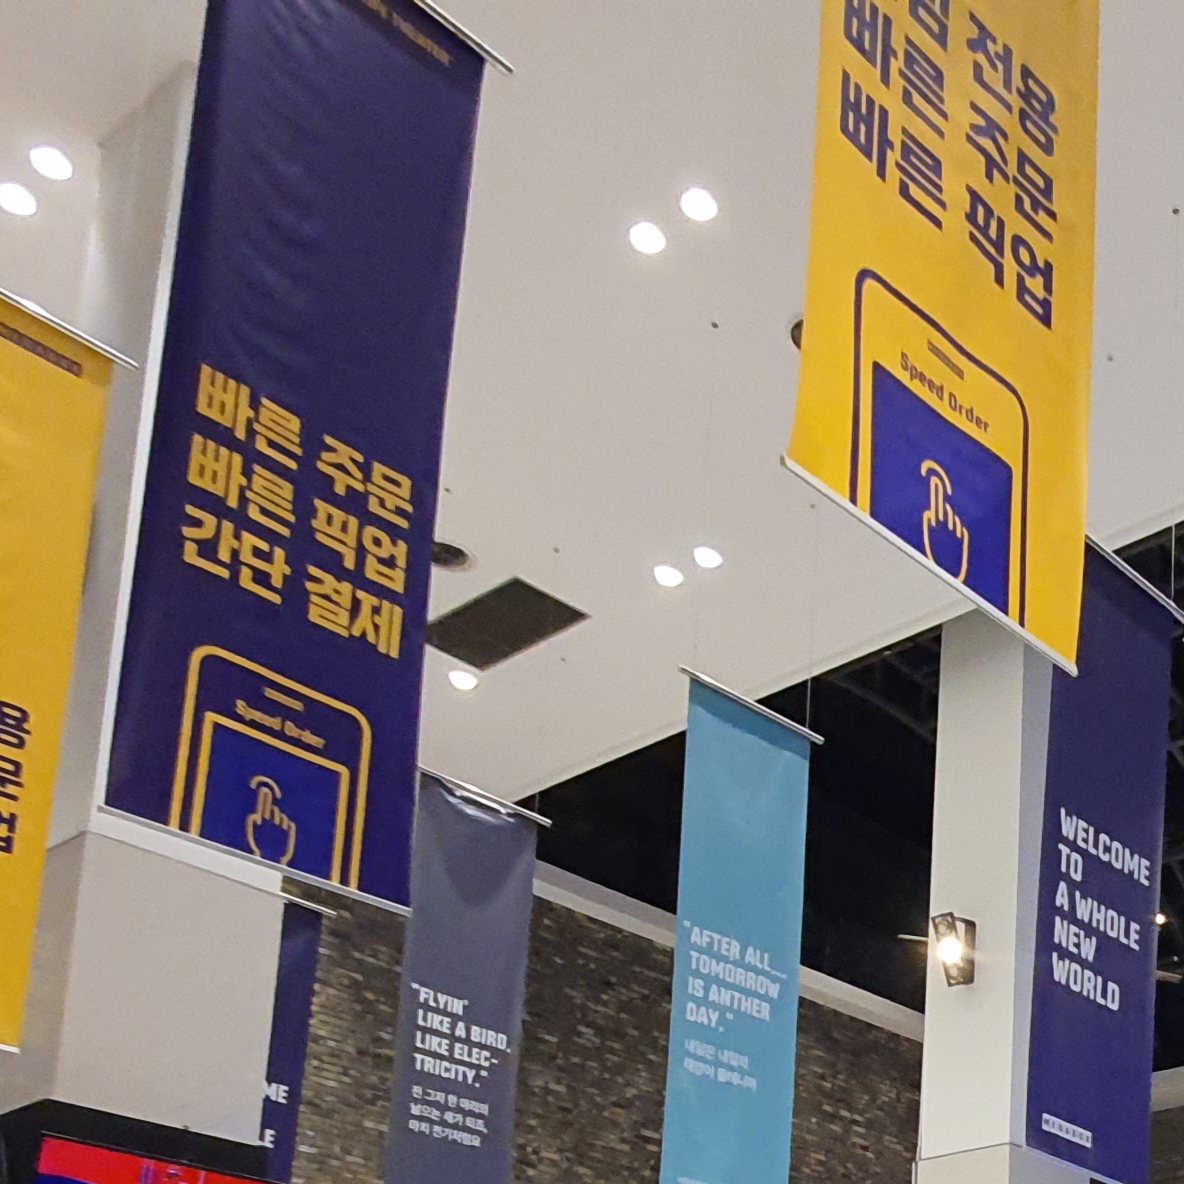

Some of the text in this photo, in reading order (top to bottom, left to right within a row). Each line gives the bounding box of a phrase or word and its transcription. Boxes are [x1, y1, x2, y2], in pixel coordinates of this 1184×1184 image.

[965, 10, 1059, 157] 전용
[844, 0, 1057, 244] 빠른 주문
[840, 66, 1054, 330] 빠른 픽업
[900, 351, 989, 433] Speed Order
[196, 362, 413, 530] 빠른 주문
[186, 432, 408, 594] 빠른 픽업
[181, 503, 404, 660] 간단 결제
[1058, 843, 1082, 882] TO
[1060, 807, 1151, 887] WELCOME
[1054, 916, 1097, 963] NEW
[1055, 880, 1141, 951] A WHOLE
[687, 975, 705, 998] IS
[689, 950, 781, 999] TOMORROW
[1052, 951, 1121, 1012] WORLD
[415, 1030, 499, 1066] LIKE ELEC-
[417, 1008, 451, 1034] LIKE
[454, 1022, 466, 1040] A
